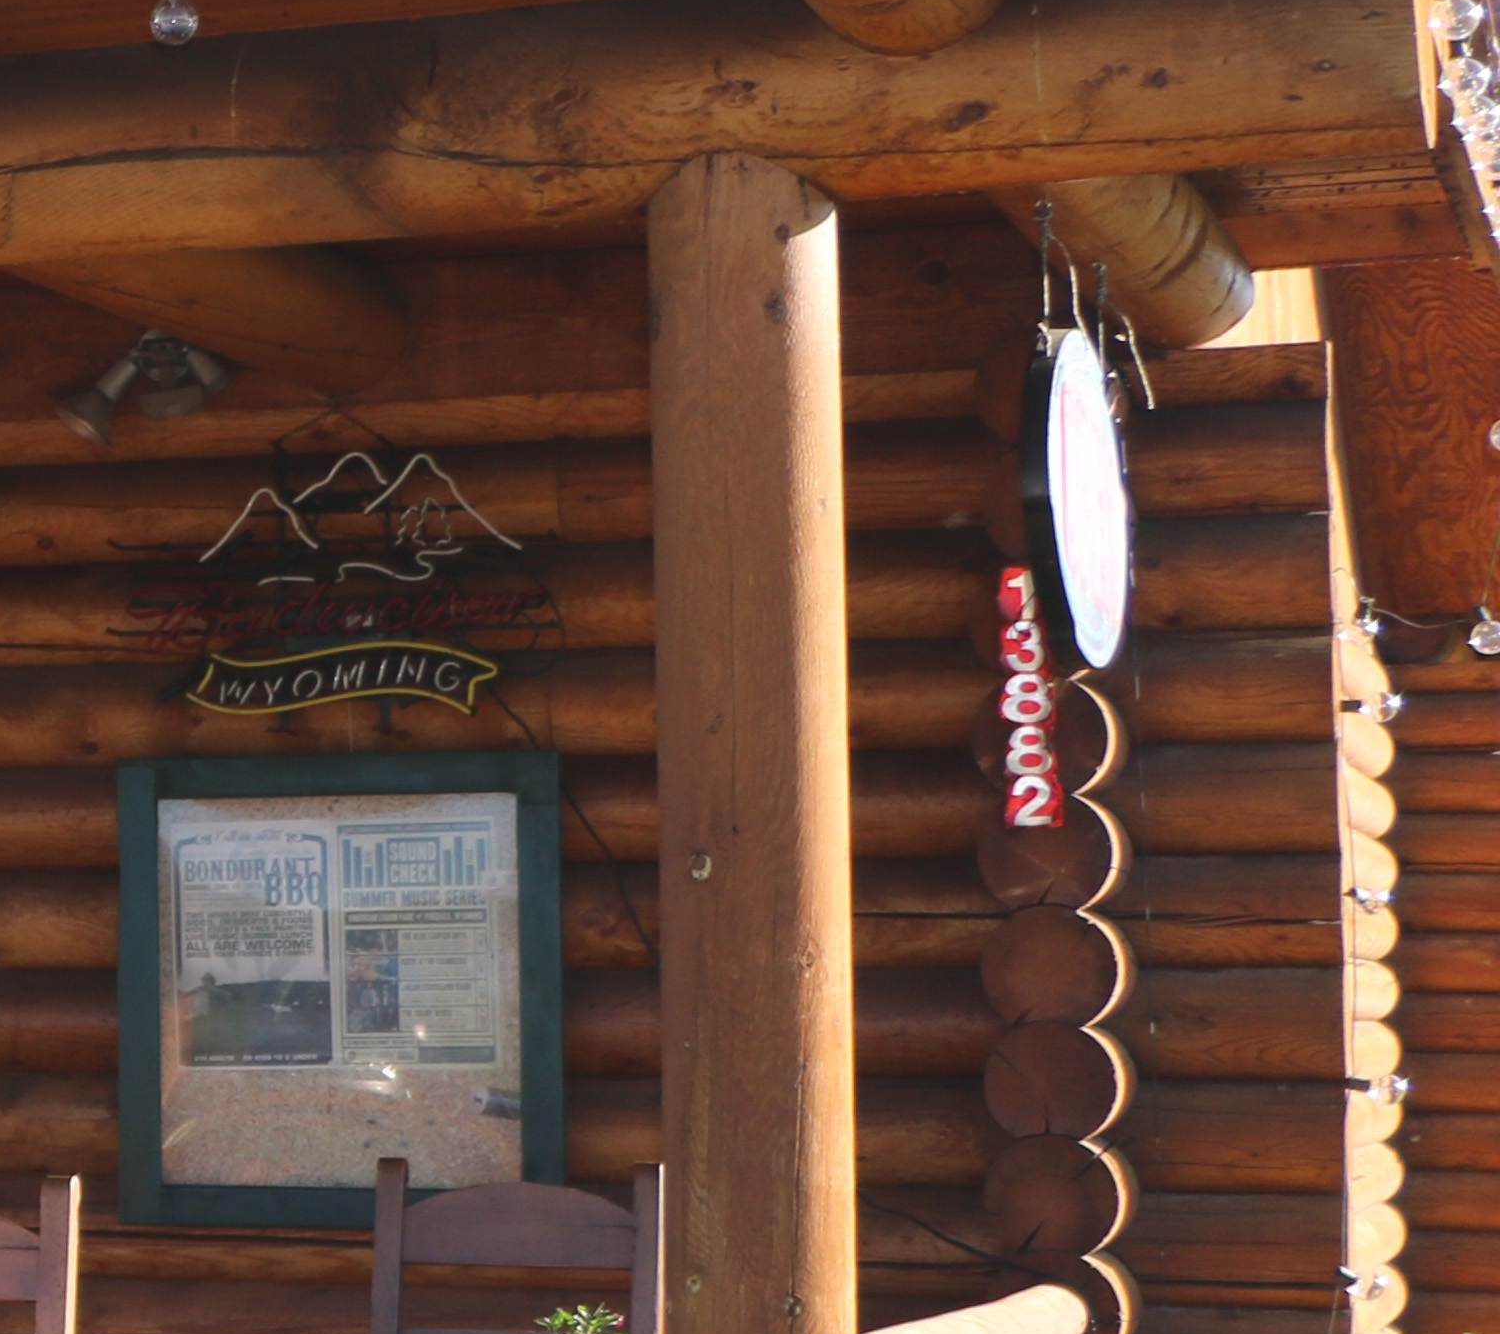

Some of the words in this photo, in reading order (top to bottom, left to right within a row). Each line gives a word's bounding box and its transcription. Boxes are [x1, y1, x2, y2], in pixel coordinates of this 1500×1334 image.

[126, 578, 549, 653] Budweiser
[218, 653, 463, 706] WYOMING
[1001, 569, 1053, 827] 13882
[388, 840, 438, 862] SOUND
[184, 856, 316, 883] BONDURANT
[390, 862, 438, 884] CHECK
[343, 890, 398, 908] SUMMER
[401, 889, 441, 907] MUSIC
[186, 942, 208, 951] ALL
[214, 941, 239, 951] ARE
[246, 939, 313, 950] WELCOME
